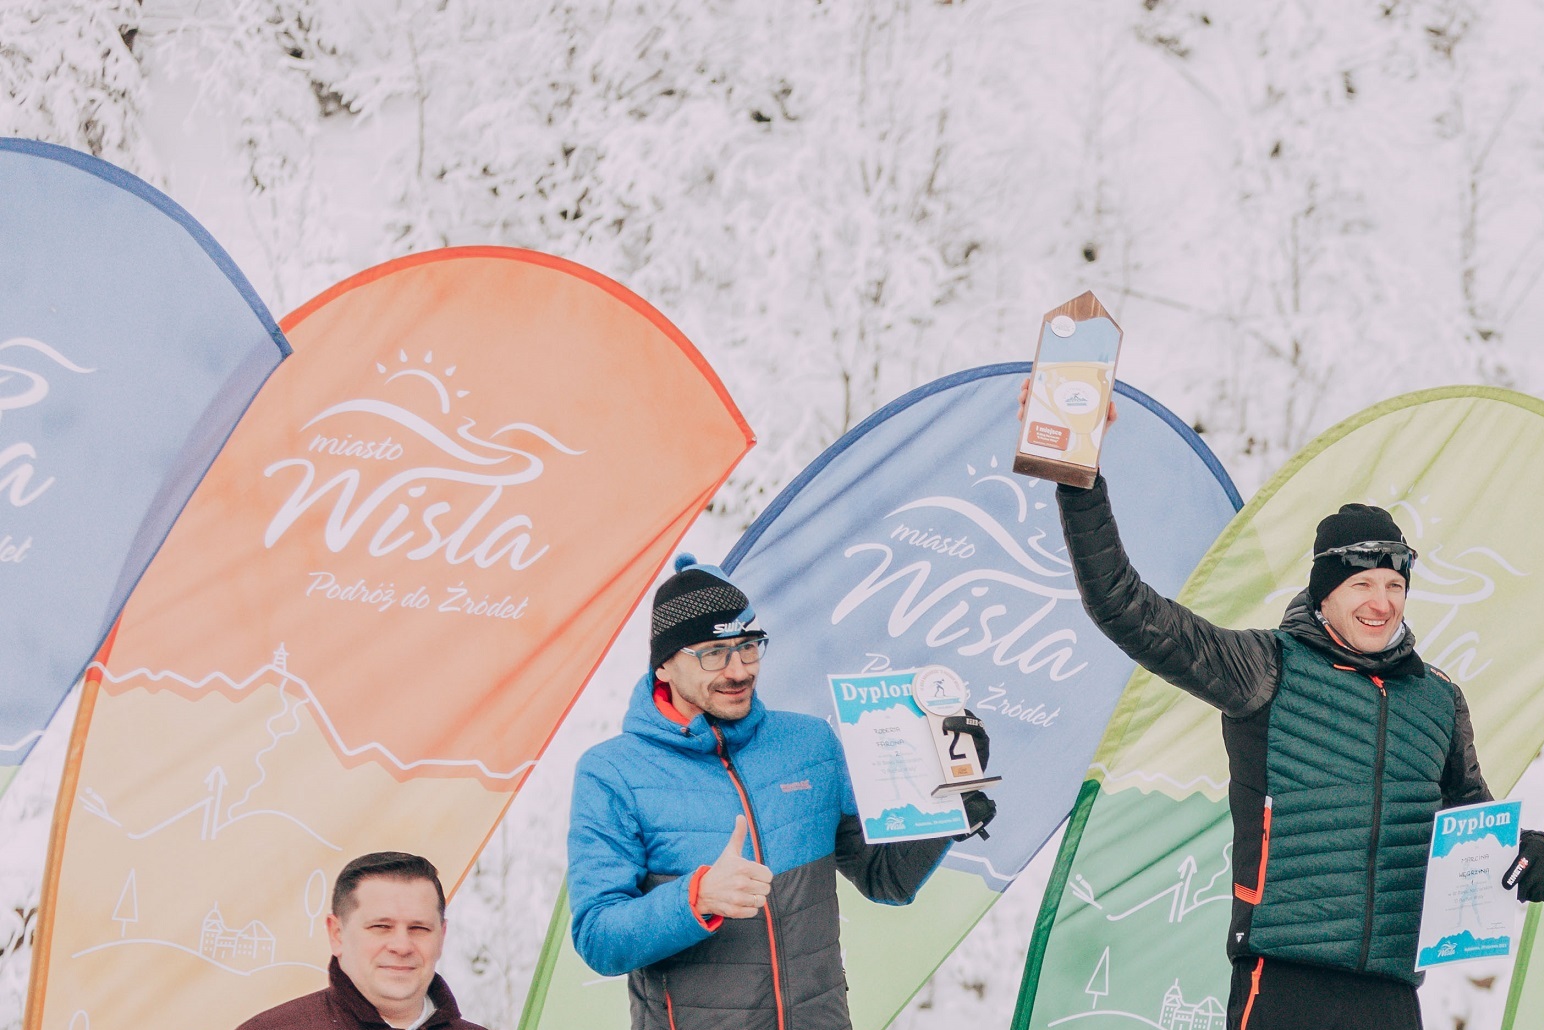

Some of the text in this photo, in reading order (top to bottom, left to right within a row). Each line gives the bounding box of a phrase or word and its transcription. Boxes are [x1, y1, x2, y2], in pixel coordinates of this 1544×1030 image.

[308, 434, 403, 460] miasto
[890, 520, 976, 559] miasto
[306, 572, 398, 611] Podróż
[401, 586, 430, 609] do
[1441, 811, 1511, 836] Dyplom
